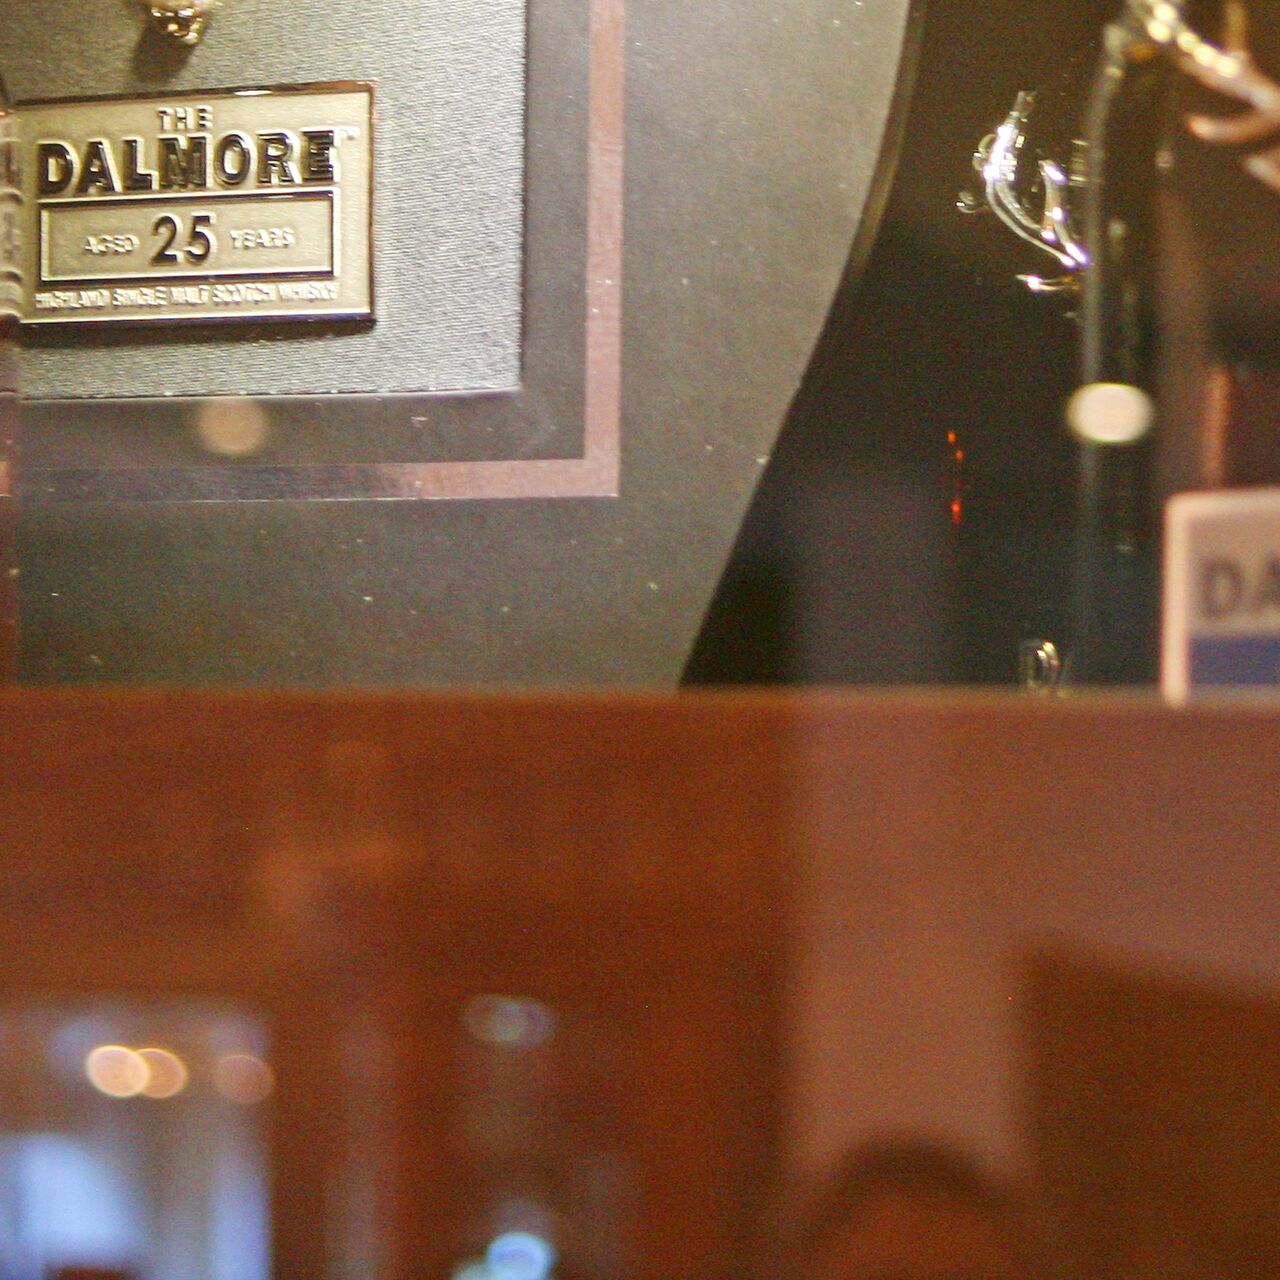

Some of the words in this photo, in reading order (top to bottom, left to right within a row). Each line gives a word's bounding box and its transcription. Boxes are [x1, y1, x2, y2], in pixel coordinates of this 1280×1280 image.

[158, 105, 214, 131] THE
[37, 127, 342, 195] DALMORE
[83, 234, 141, 256] AGED
[151, 213, 218, 267] 25
[228, 227, 297, 251] YEARS
